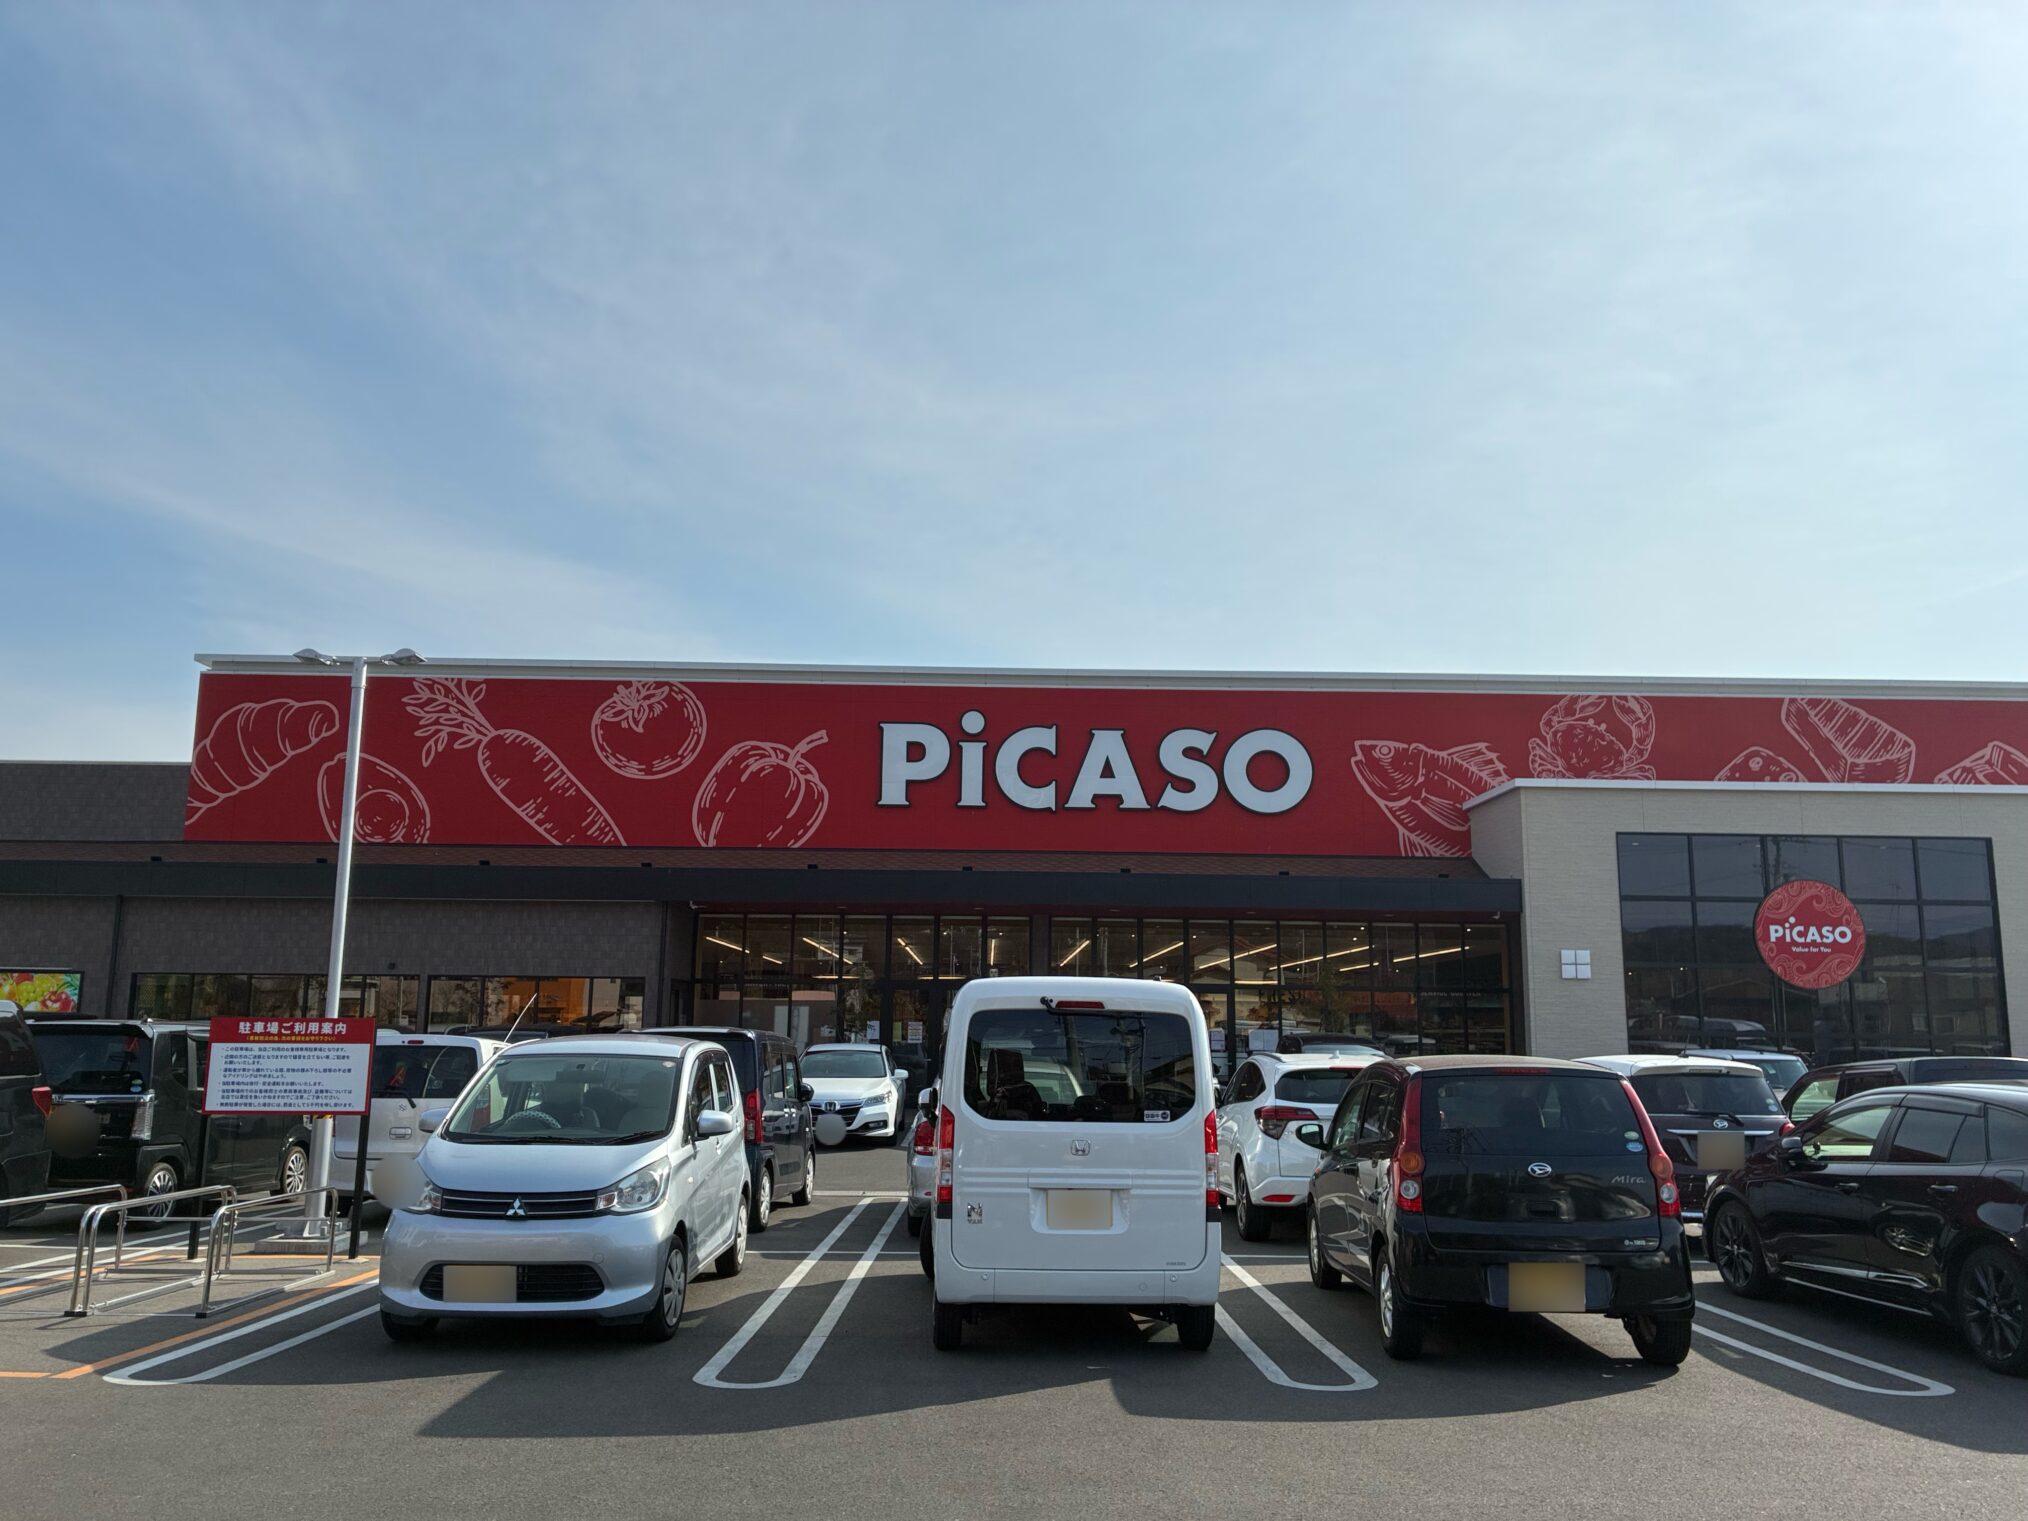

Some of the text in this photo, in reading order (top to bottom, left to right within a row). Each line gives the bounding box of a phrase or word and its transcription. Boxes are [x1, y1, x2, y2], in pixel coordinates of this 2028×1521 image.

[877, 710, 1313, 814] PiCASO
[1769, 916, 1852, 944] PiCASO
[238, 1021, 347, 1035] 駐車場ご利用案内
[1611, 1175, 1646, 1184] Mira
